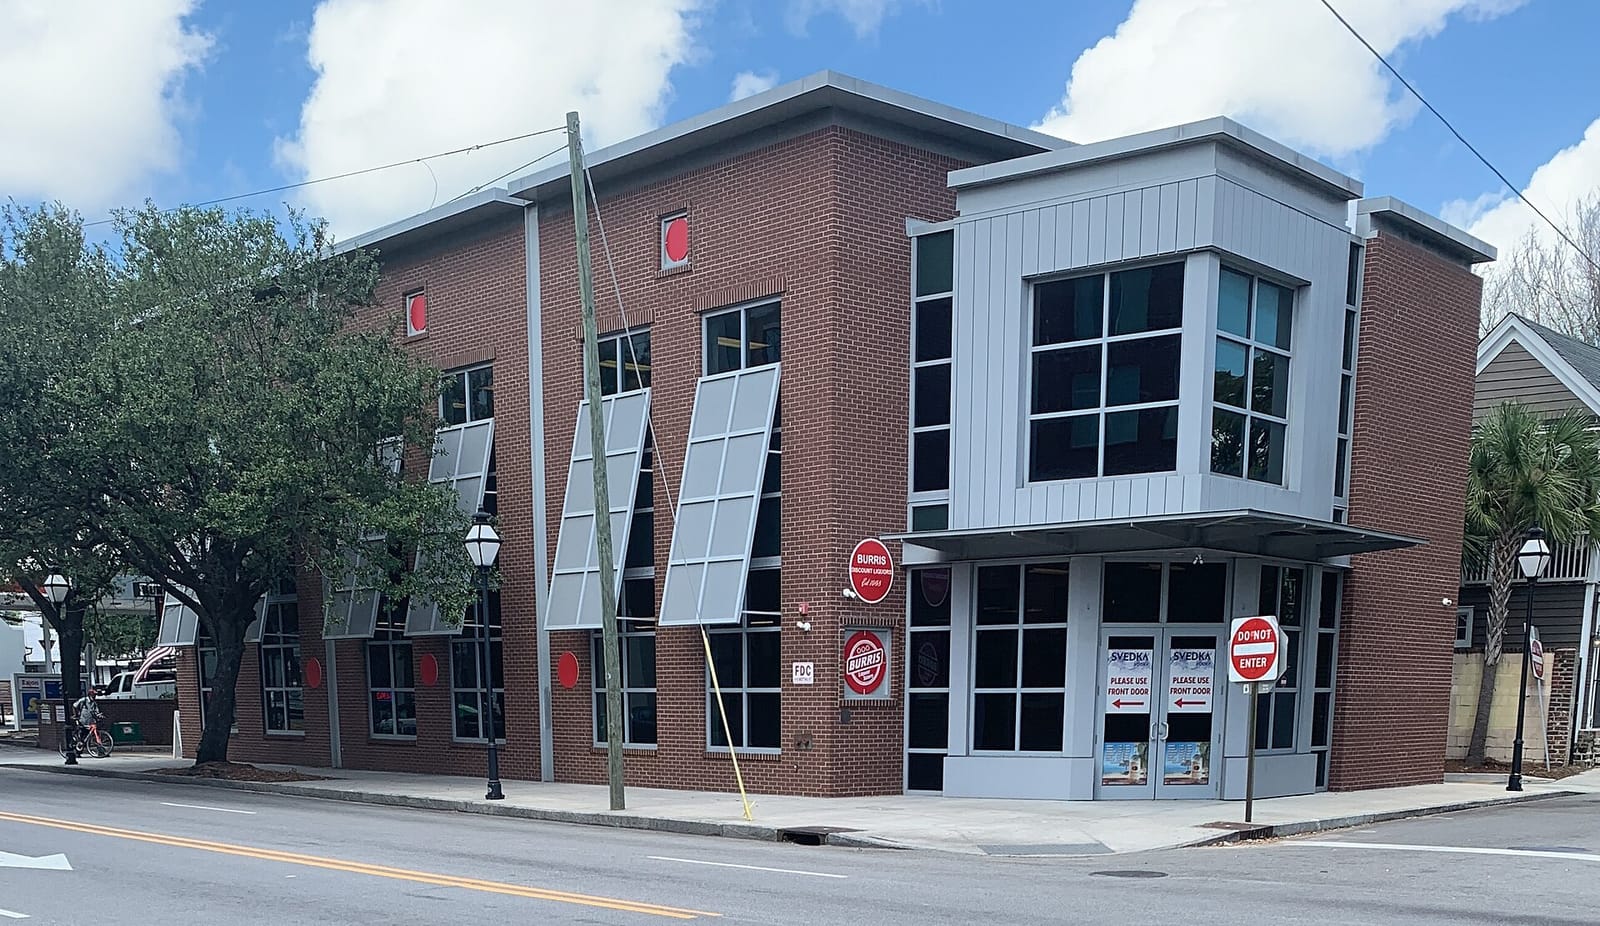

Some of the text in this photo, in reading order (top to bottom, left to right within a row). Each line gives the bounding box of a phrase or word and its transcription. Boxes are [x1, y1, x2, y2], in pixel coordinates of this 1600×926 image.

[857, 554, 887, 566] BURRIS
[851, 566, 873, 574] DISCOUNT
[1237, 628, 1272, 641] DO NOT
[848, 651, 881, 670] BURRIS
[1111, 652, 1149, 661] SVEDKA
[1173, 651, 1211, 661] SVEDKA
[1239, 657, 1267, 669] ENTER
[794, 665, 812, 677] FDC
[1110, 677, 1148, 685] PLEASE USE
[1172, 676, 1210, 684] PLEASE USE
[1169, 687, 1211, 695] FRONT DOOR
